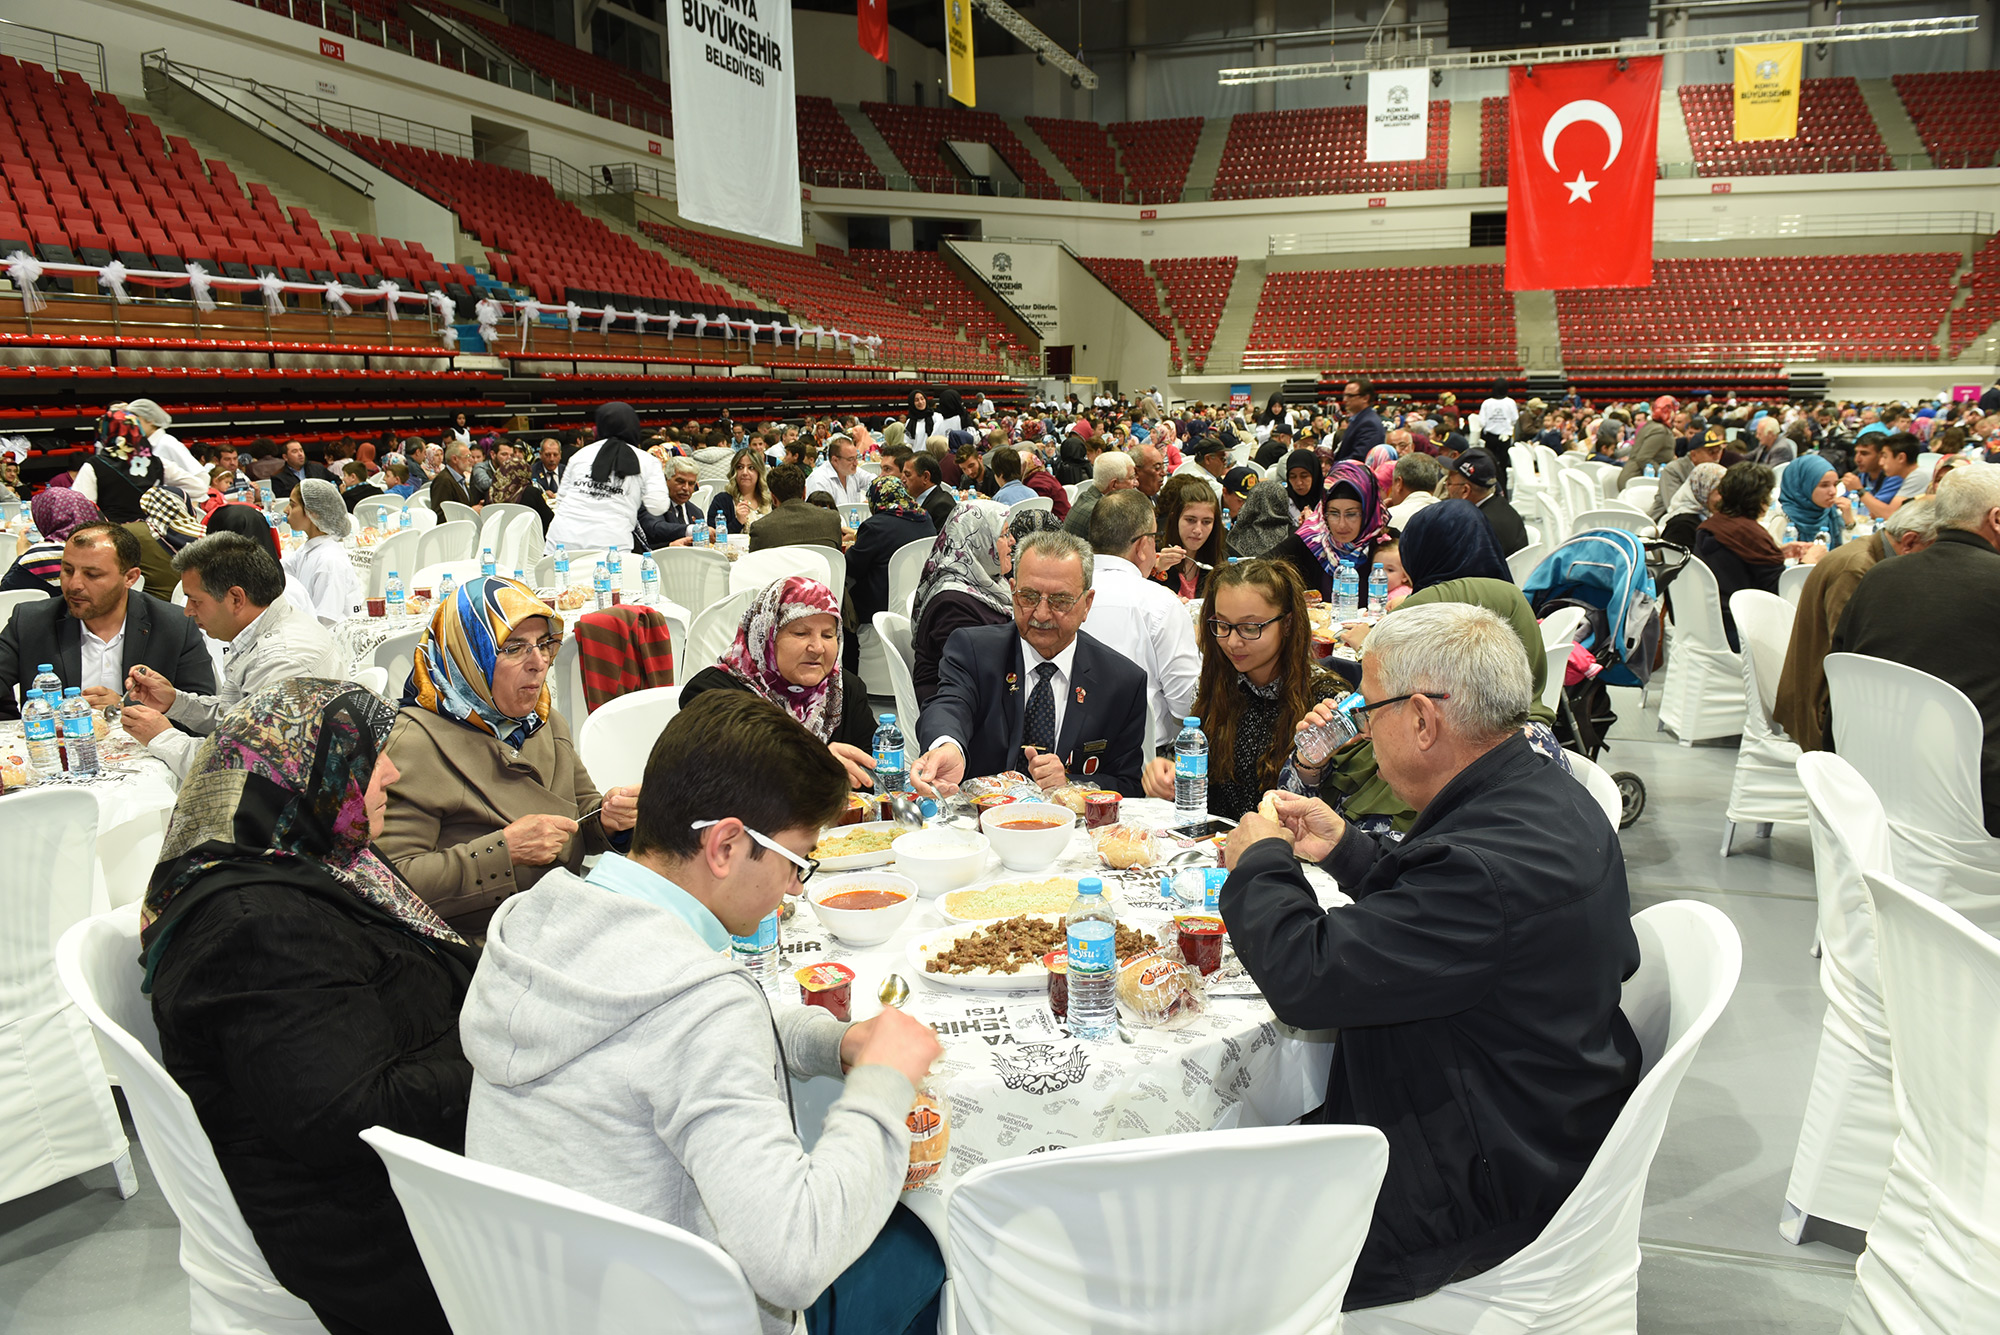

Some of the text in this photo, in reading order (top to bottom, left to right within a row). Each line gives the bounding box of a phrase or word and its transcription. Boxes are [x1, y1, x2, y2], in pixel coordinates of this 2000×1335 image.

[717, 0, 758, 22] NYA
[682, 0, 782, 72] BÜYÜKŞEHİR
[322, 42, 342, 58] VIP 1
[705, 43, 765, 88] BELEDİYESİ
[1069, 944, 1096, 960] beysu
[1002, 1123, 1021, 1134] KONYA
